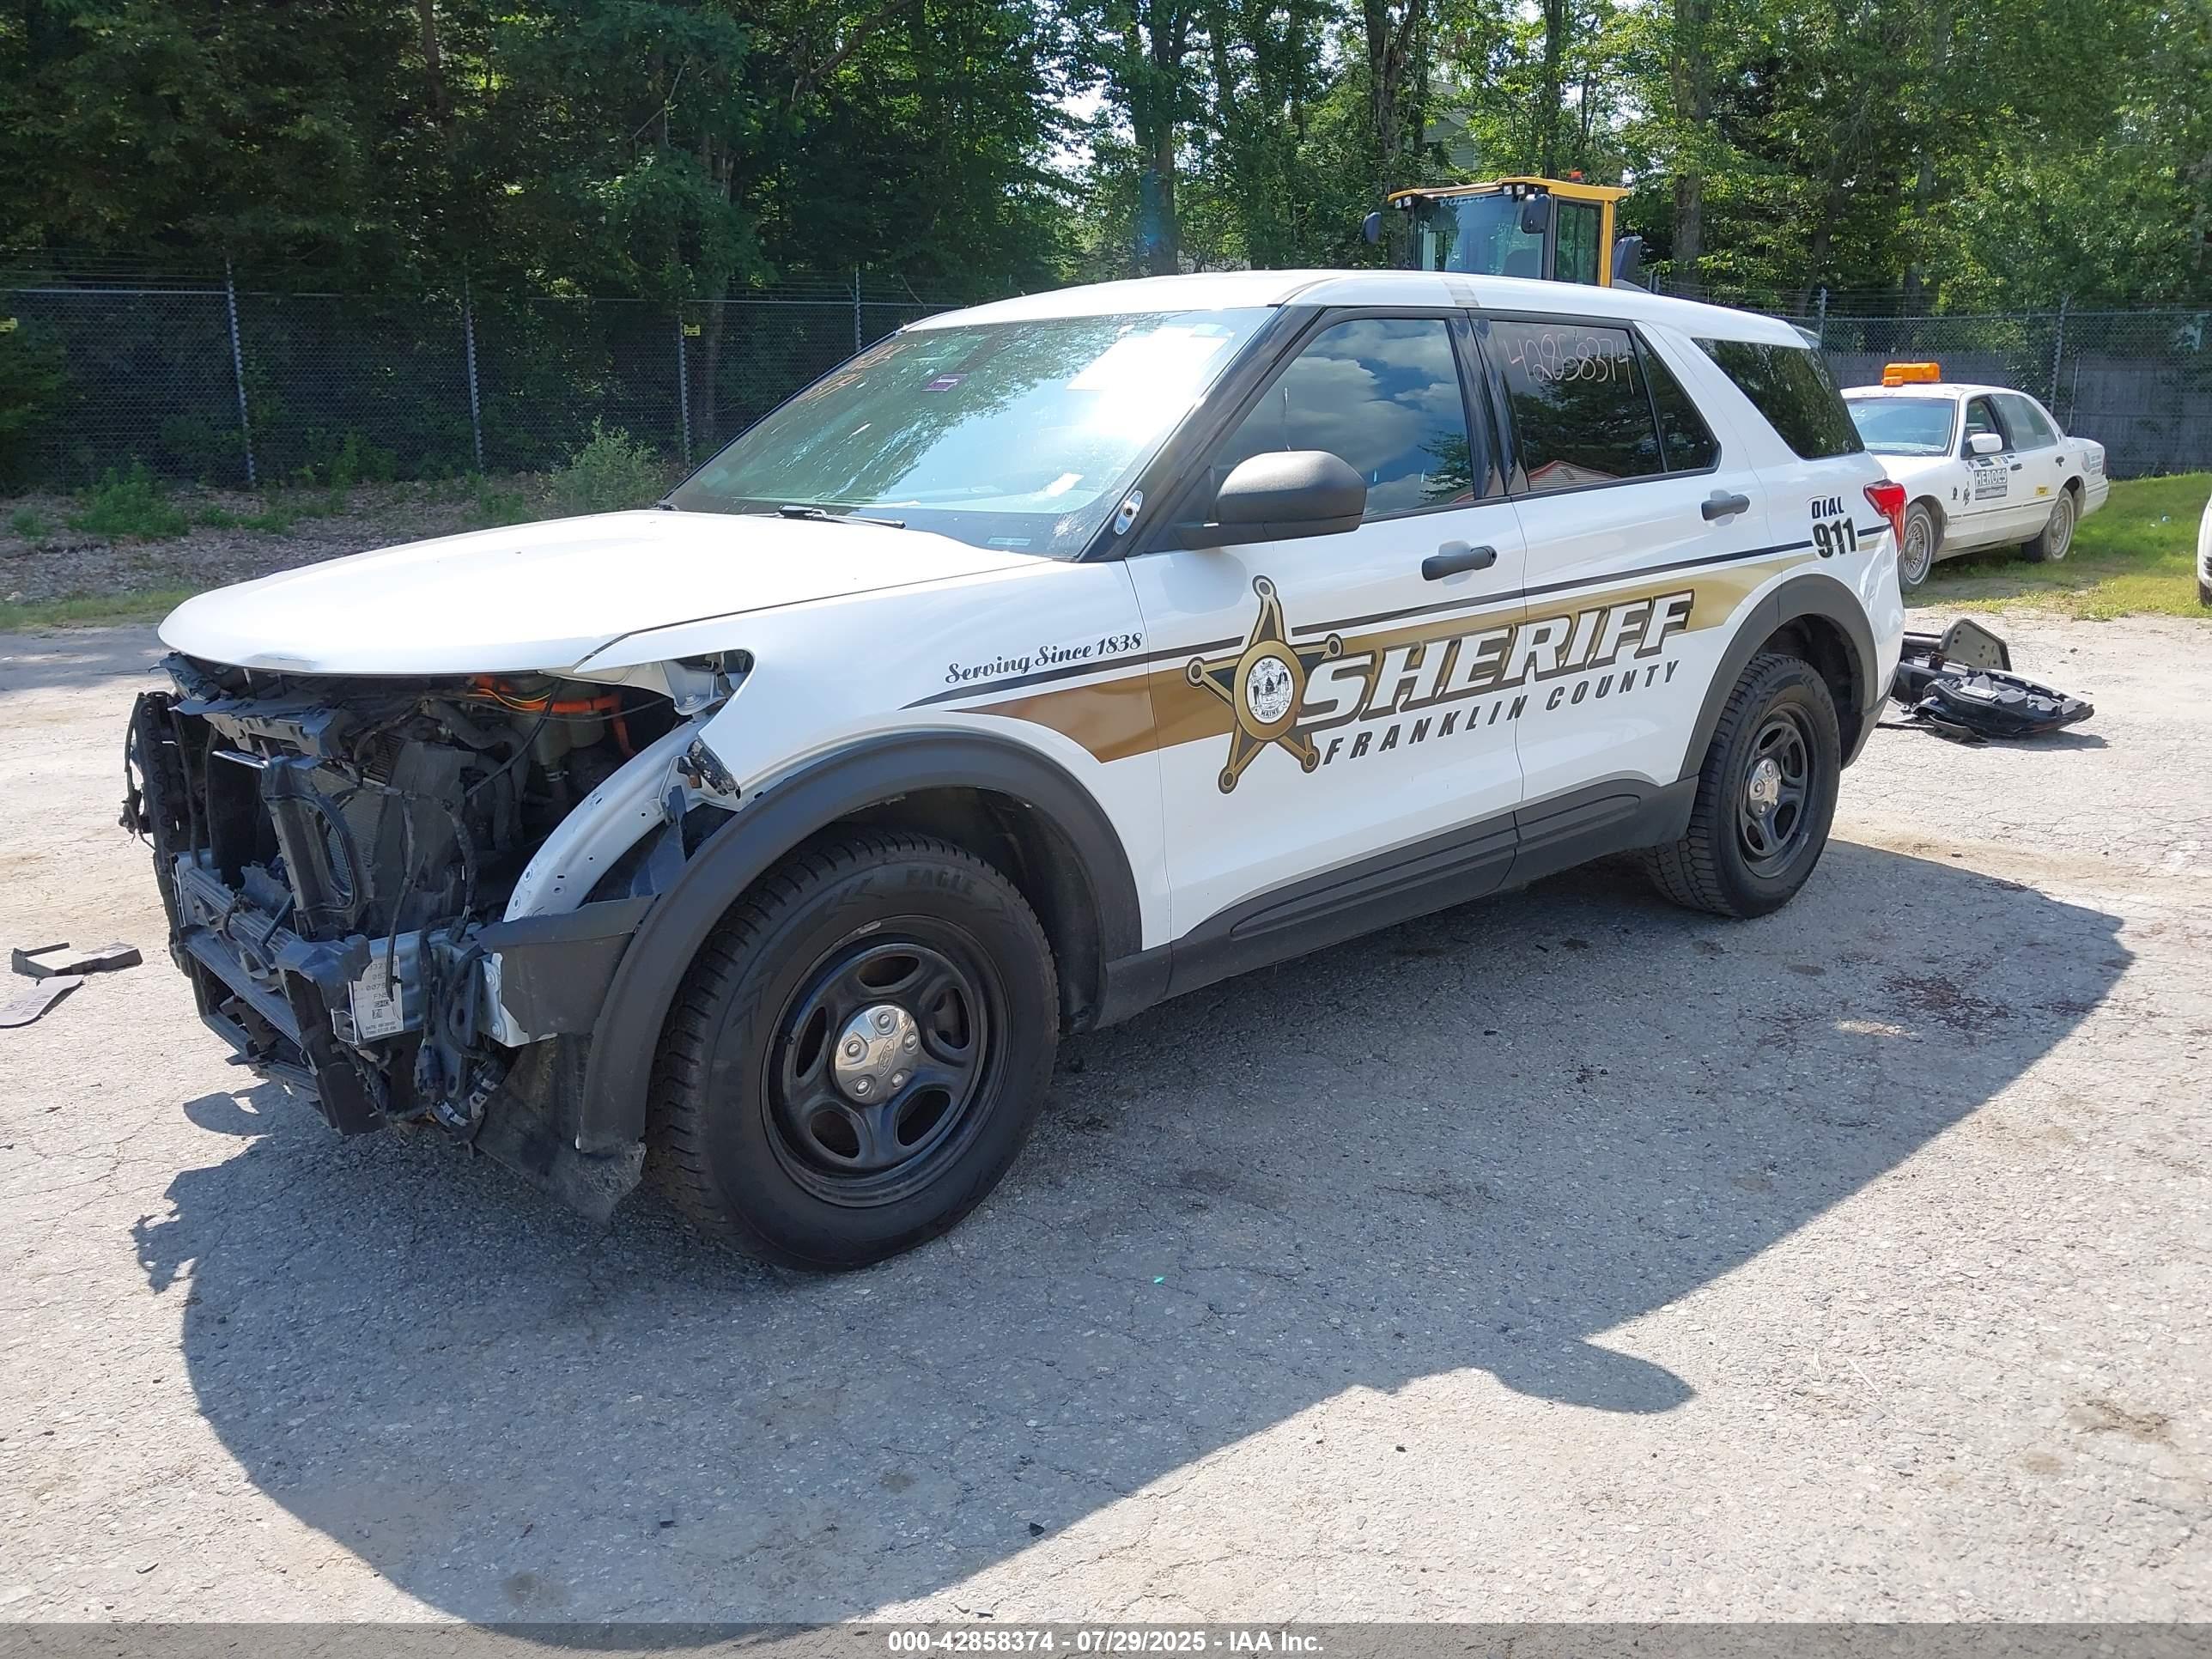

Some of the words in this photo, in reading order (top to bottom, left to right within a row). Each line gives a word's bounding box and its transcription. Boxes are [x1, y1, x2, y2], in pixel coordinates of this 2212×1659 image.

[1811, 495, 1845, 520] DIAL
[1812, 516, 1857, 559] 911
[945, 656, 1033, 684] Serving
[1034, 645, 1094, 666] Since
[1096, 632, 1143, 656] 1838
[1297, 589, 1695, 731] SHERIFF
[1322, 695, 1528, 766] FRANKLIN
[1545, 659, 1680, 712] COUNTY
